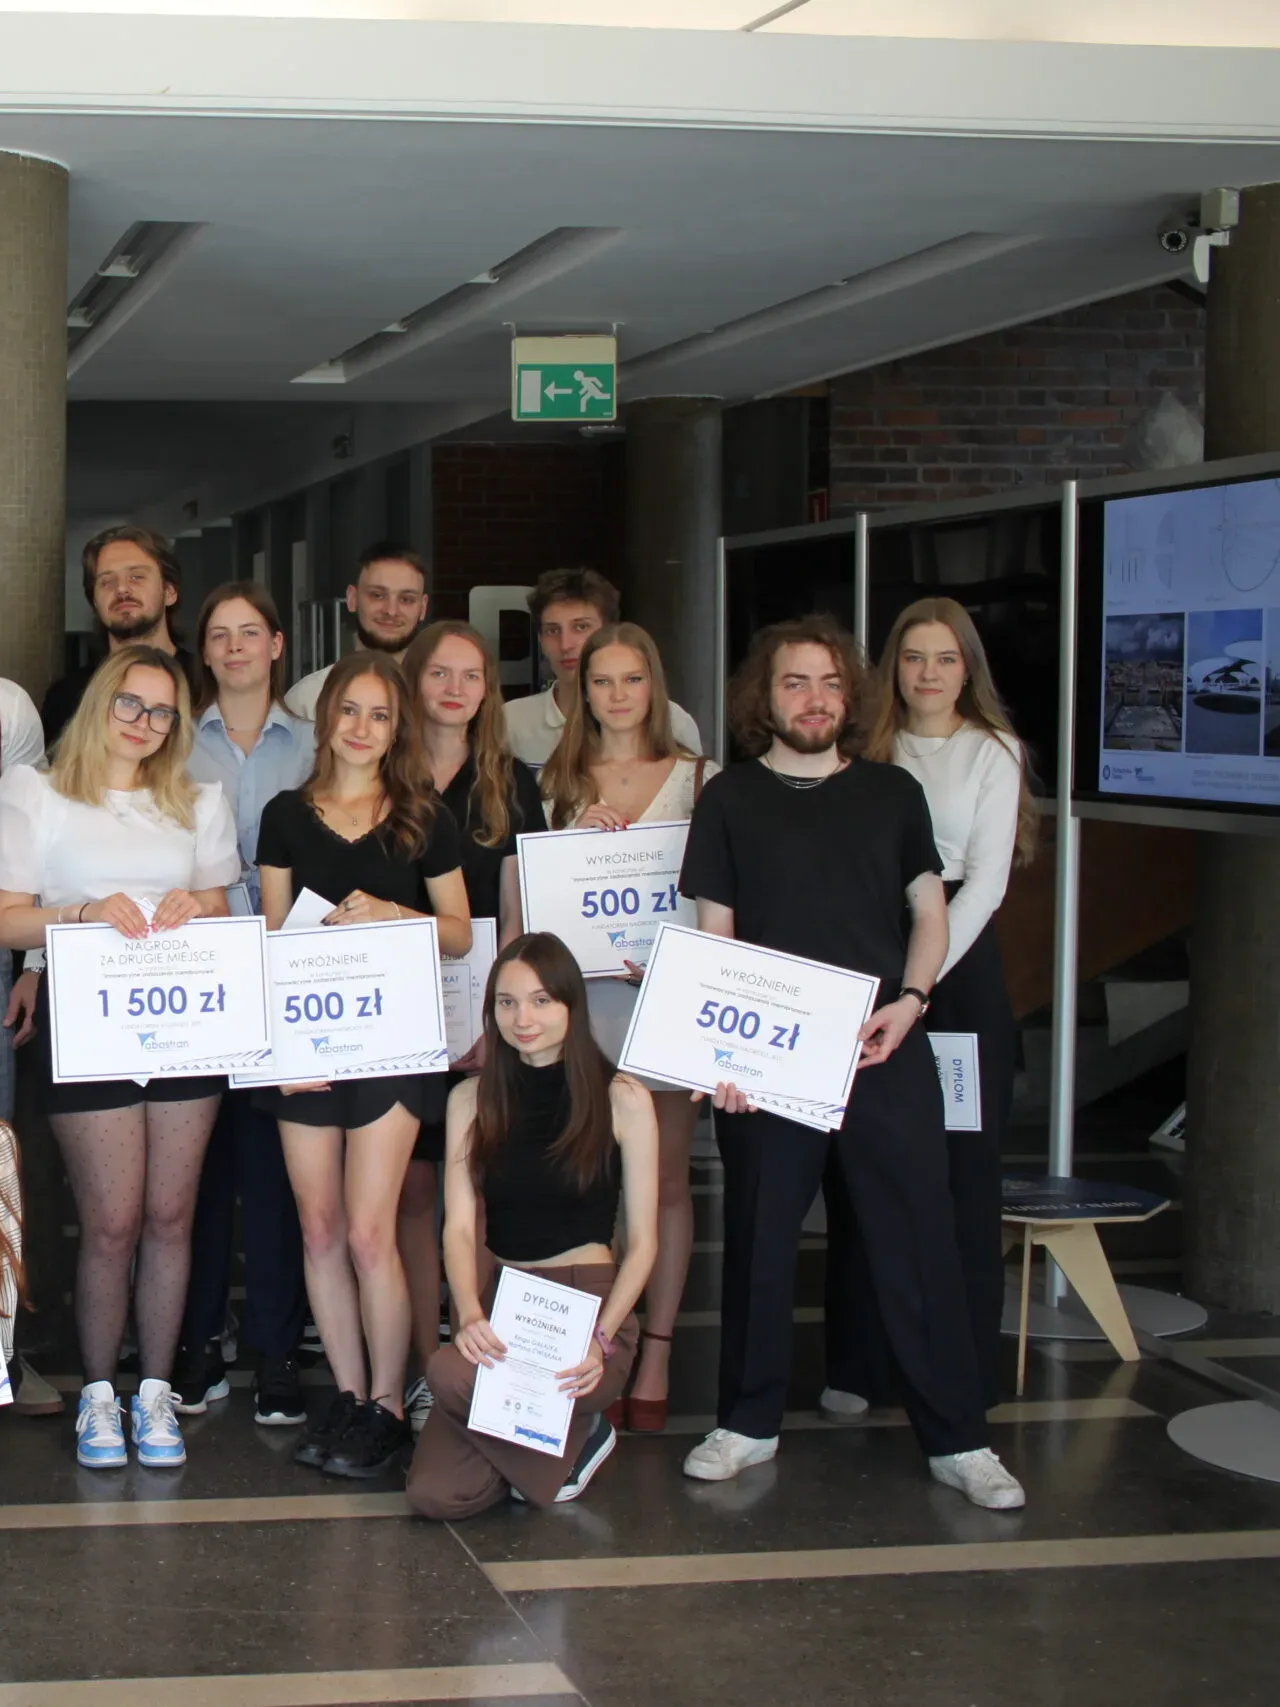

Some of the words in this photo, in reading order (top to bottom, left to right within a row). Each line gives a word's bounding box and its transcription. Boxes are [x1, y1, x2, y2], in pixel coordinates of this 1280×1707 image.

[586, 850, 664, 865] WYRÓŻNIENIE
[581, 887, 640, 918] 500
[651, 883, 678, 912] zł
[124, 939, 190, 951] NAGRODA
[615, 937, 654, 948] abastra
[100, 954, 115, 966] ZA
[118, 953, 163, 966] DRUGIE
[167, 950, 216, 963] MIEJSCE
[289, 952, 369, 969] WYRÓŻNIENIE
[720, 966, 801, 997] WYRÓŻNIENIE
[97, 989, 109, 1018] 1
[126, 985, 188, 1017] 500
[199, 983, 226, 1013] zł
[283, 991, 344, 1024] 500
[356, 987, 383, 1017] zł
[696, 1000, 760, 1040] 500
[768, 1022, 801, 1051] zł
[952, 1058, 964, 1103] DYPLOM
[523, 1292, 569, 1315] DYPLOM
